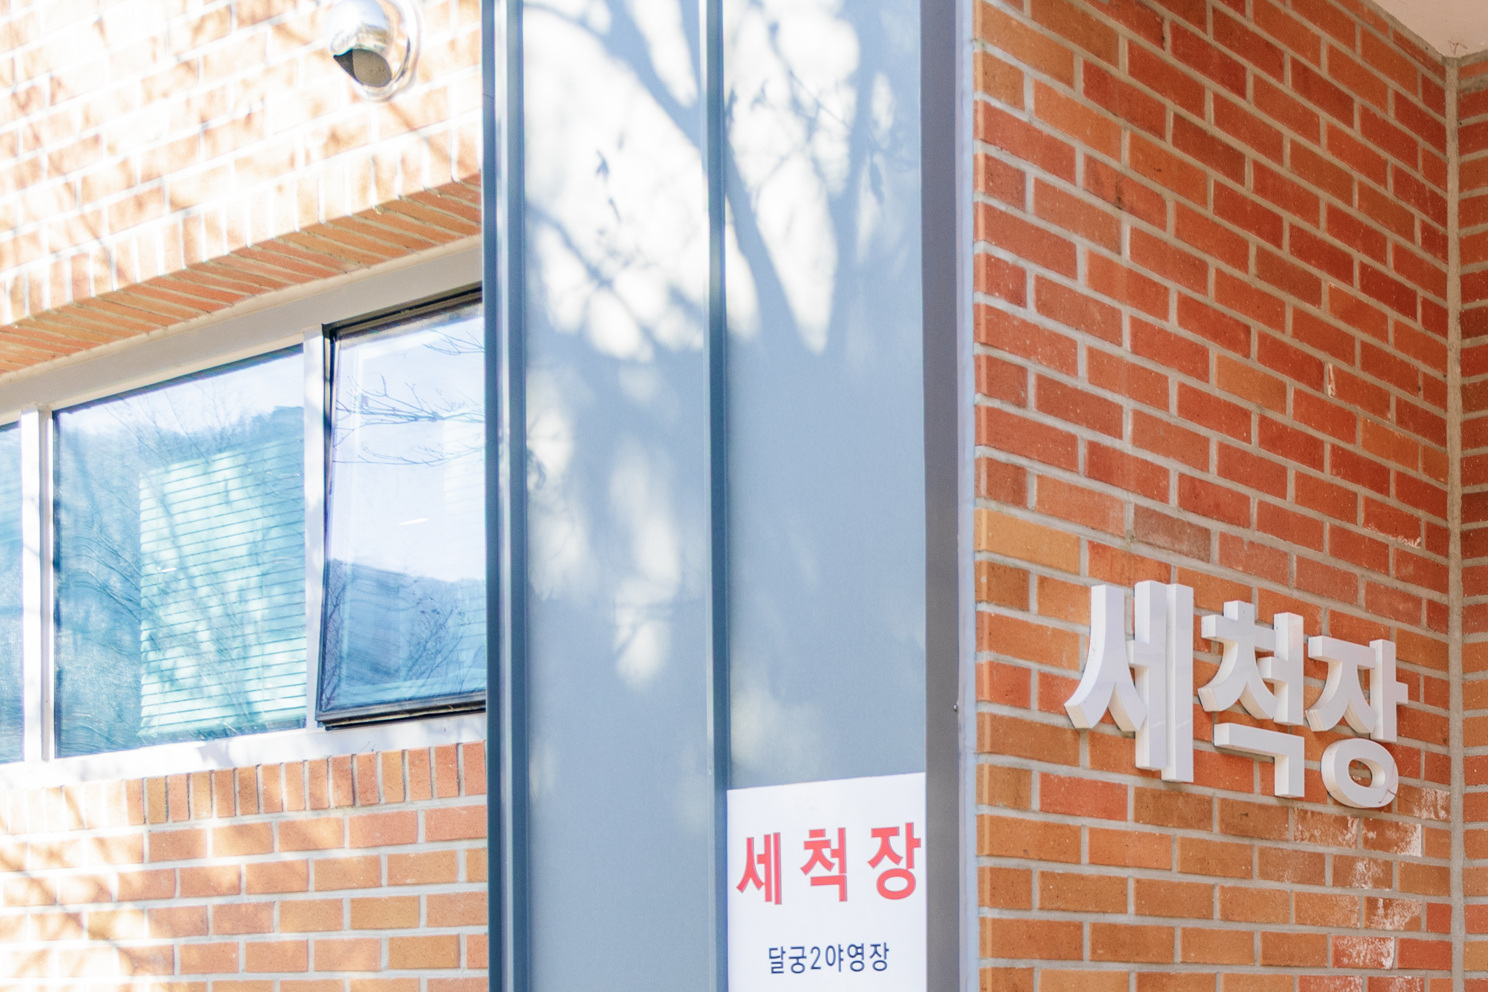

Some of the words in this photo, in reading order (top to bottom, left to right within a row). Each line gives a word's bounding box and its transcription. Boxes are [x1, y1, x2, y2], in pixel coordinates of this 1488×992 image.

[1064, 580, 1408, 809] 세척장
[736, 822, 921, 905] 세척장
[768, 942, 890, 975] 달궁2야영장
